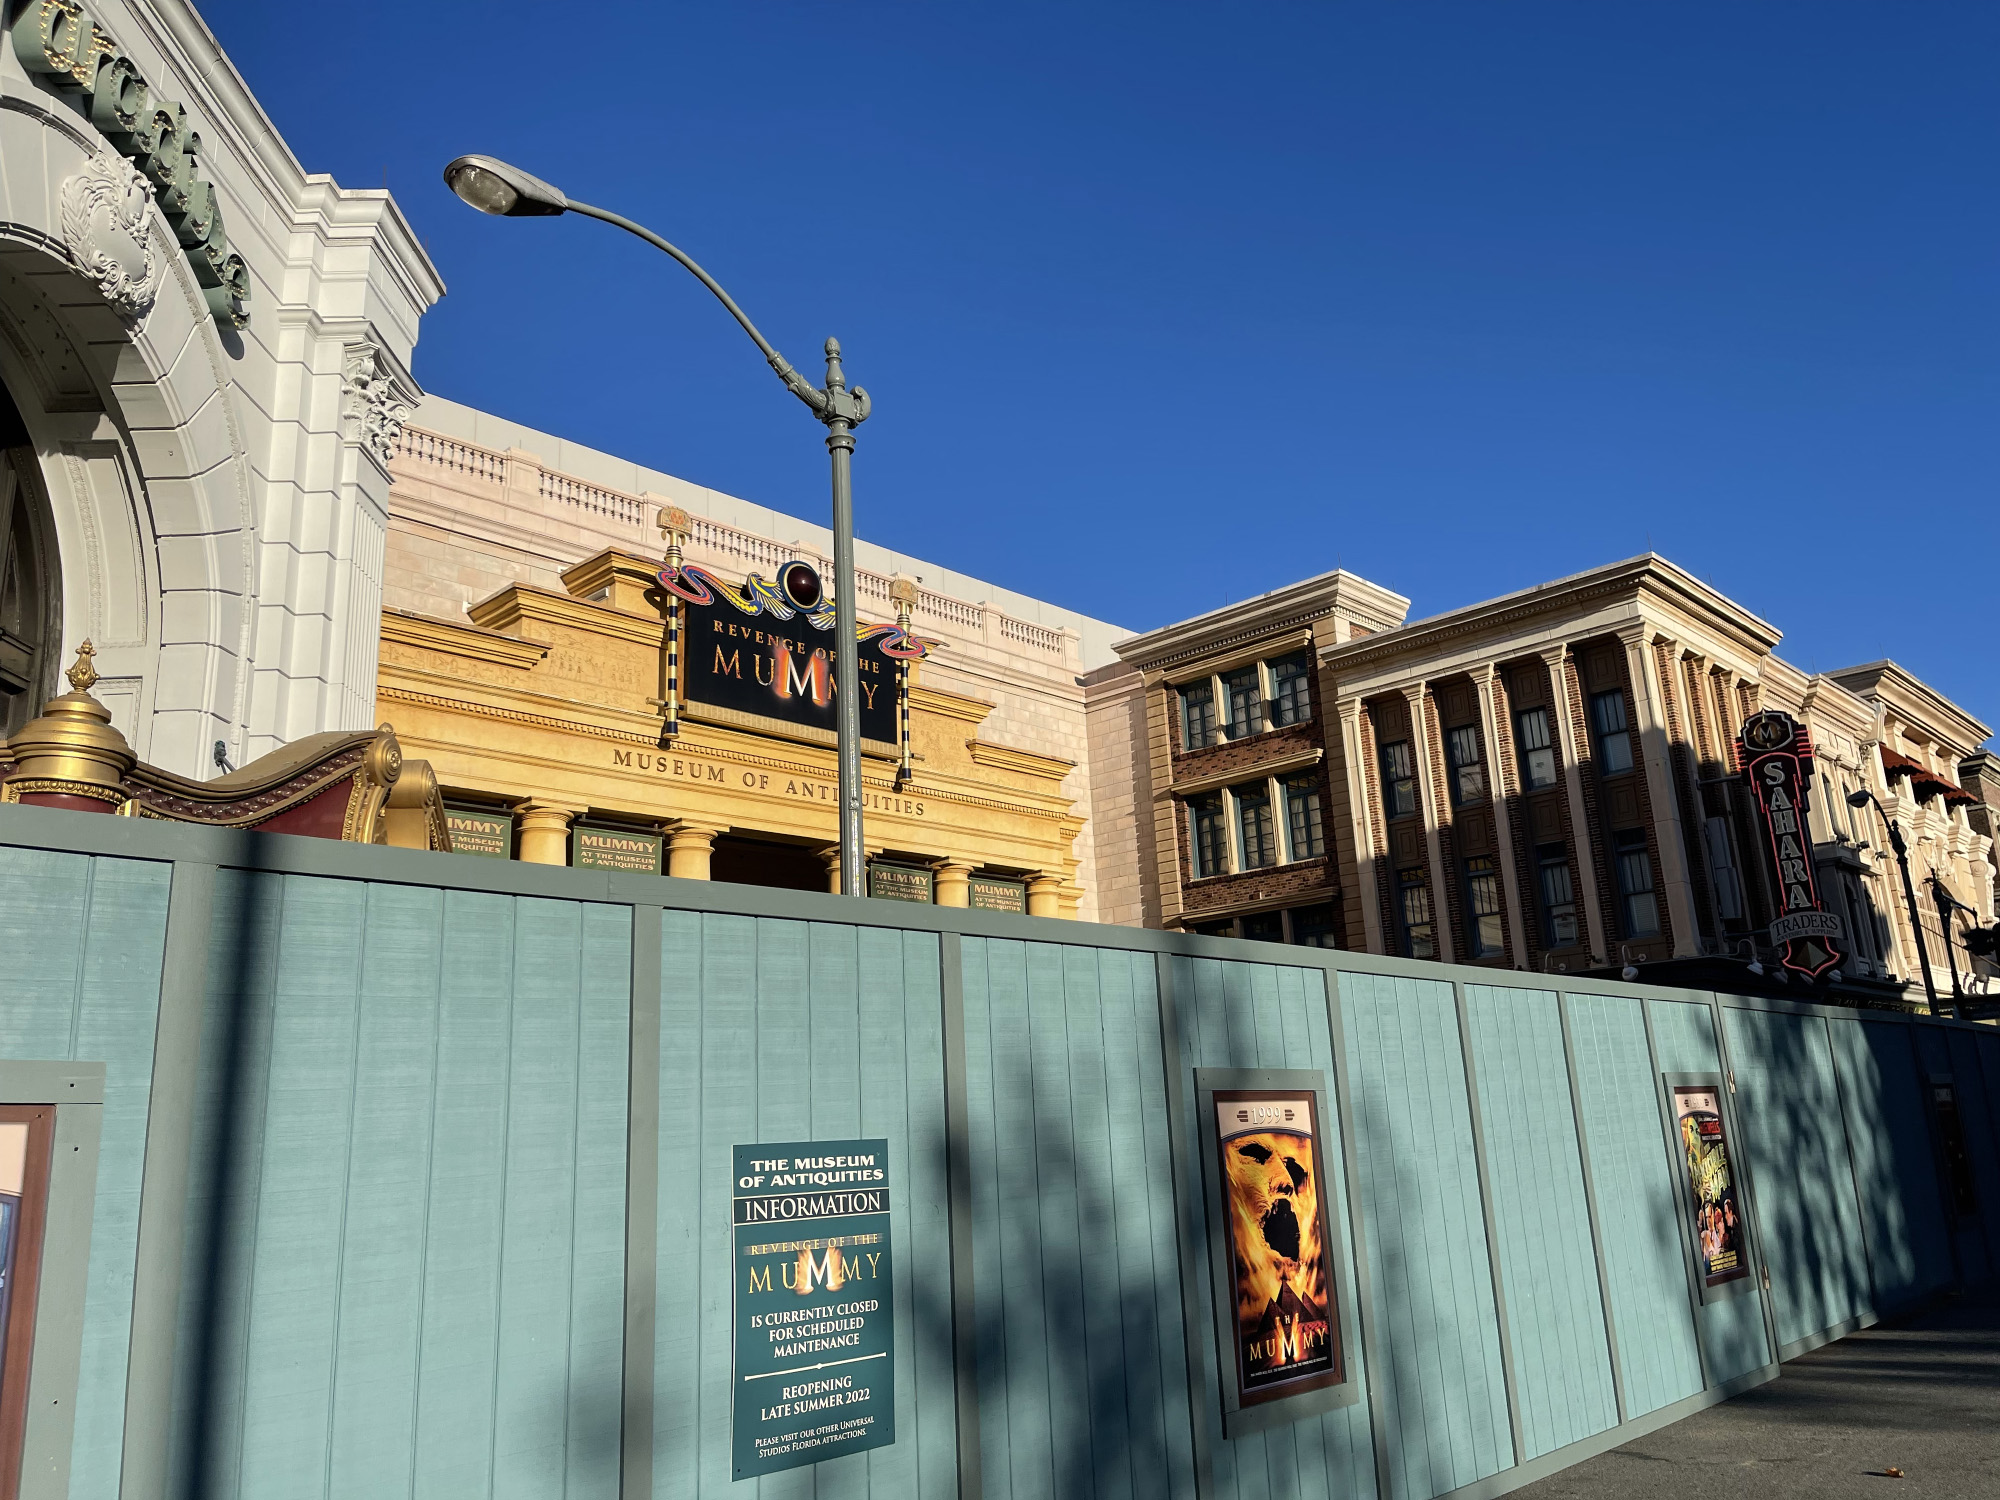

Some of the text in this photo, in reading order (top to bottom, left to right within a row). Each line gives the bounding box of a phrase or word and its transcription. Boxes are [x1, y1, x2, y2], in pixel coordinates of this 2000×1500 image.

[713, 619, 880, 674] REVENGE OF HE
[613, 749, 925, 816] MUSEUM OF ANTIUITIES
[458, 836, 504, 847] MUSEUM
[581, 834, 656, 853] MUMMY
[1763, 761, 1812, 909] SAHARA
[595, 852, 614, 860] THE
[616, 855, 656, 865] MUSEUM
[597, 859, 654, 871] ANTIQUITIES
[875, 870, 929, 886] MUMMY
[887, 891, 928, 901] ANTIQUITIES
[900, 887, 929, 896] MUSEUM
[974, 884, 1021, 898] MUMMY
[1773, 914, 1838, 936] TRADERS
[1250, 1106, 1281, 1126] 1999
[750, 1154, 875, 1173] THE MUSEUM
[739, 1168, 884, 1189] OF ANTIQUITIES
[745, 1191, 881, 1221] INFORMATION
[751, 1233, 878, 1256] REVENGE OF THE
[748, 1250, 881, 1294] MUMMY
[751, 1299, 879, 1329] IS CURRENTLY CLOSED
[1275, 1312, 1299, 1326] THE
[769, 1316, 865, 1342] FOR SCHEDULED
[773, 1333, 860, 1359] MAINTENANCE
[1250, 1327, 1326, 1362] MUMMY
[782, 1375, 853, 1400] REOPENING
[761, 1388, 871, 1421] LATE SUMMER 2022
[755, 1415, 875, 1448] PLEASE VISIT OUR OTHER UNIVERSAL
[759, 1444, 791, 1459] STUDIOS
[792, 1437, 821, 1452] FLORIDA
